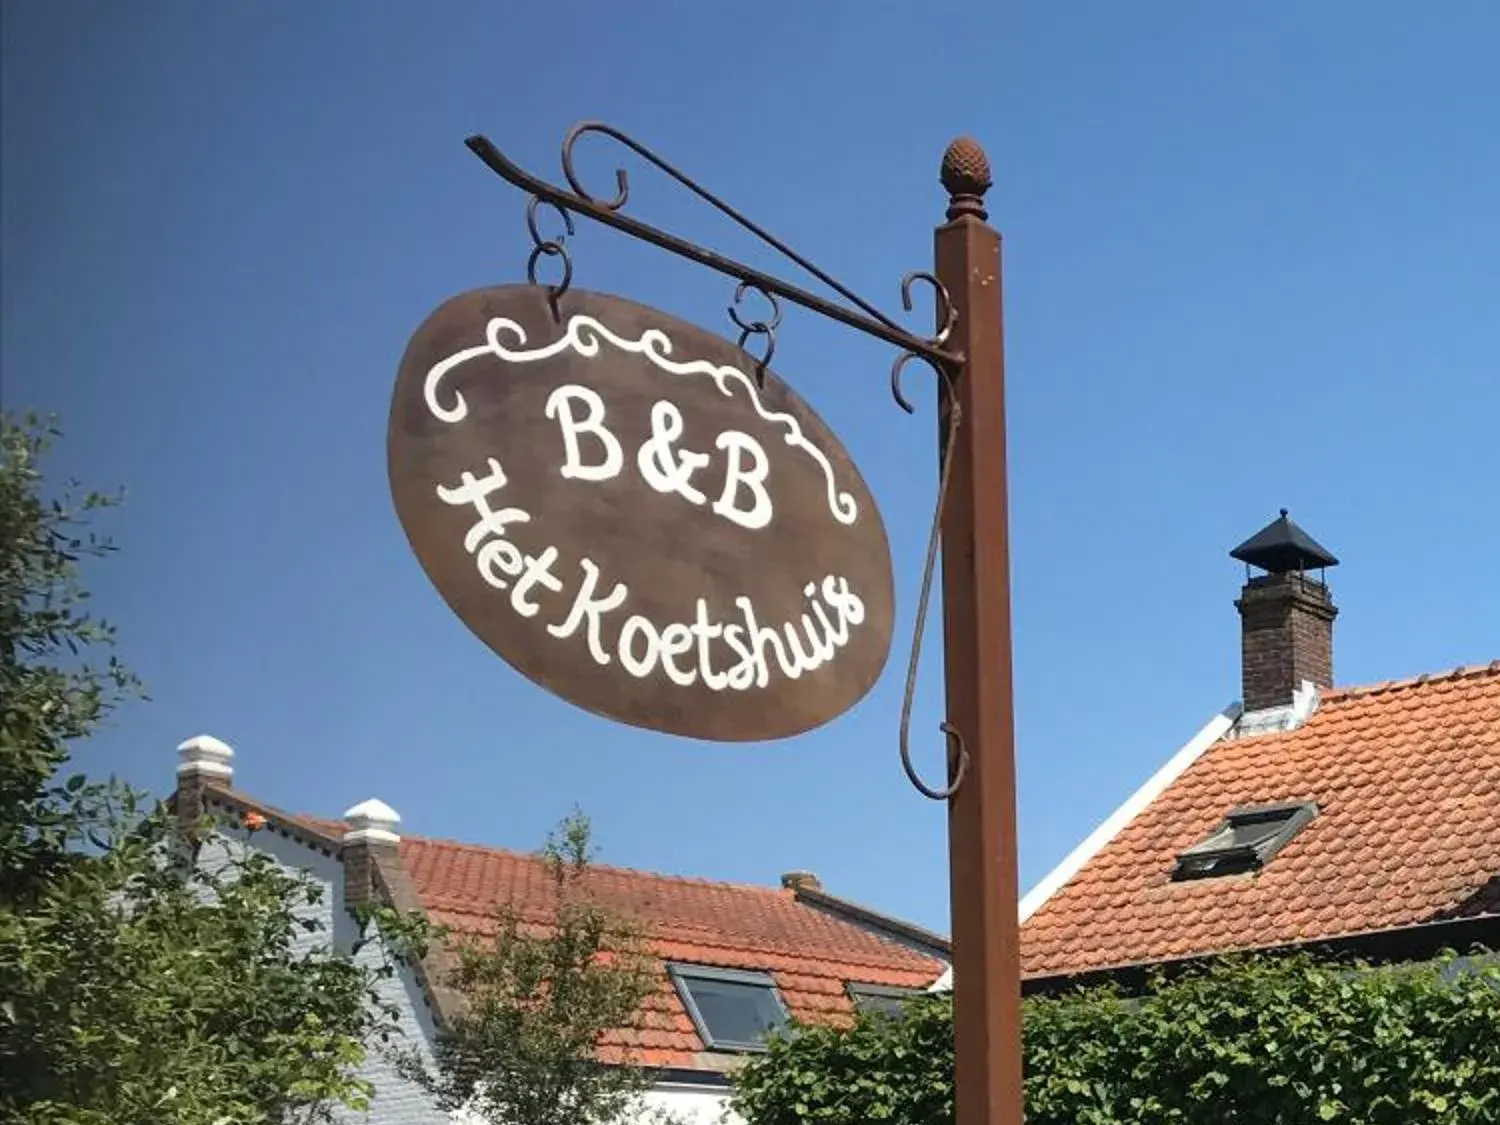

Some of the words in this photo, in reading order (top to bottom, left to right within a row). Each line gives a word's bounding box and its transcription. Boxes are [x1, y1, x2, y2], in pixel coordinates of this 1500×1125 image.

[545, 384, 773, 530] B&B
[436, 457, 563, 618] Het
[546, 557, 865, 691] Koetshuis
